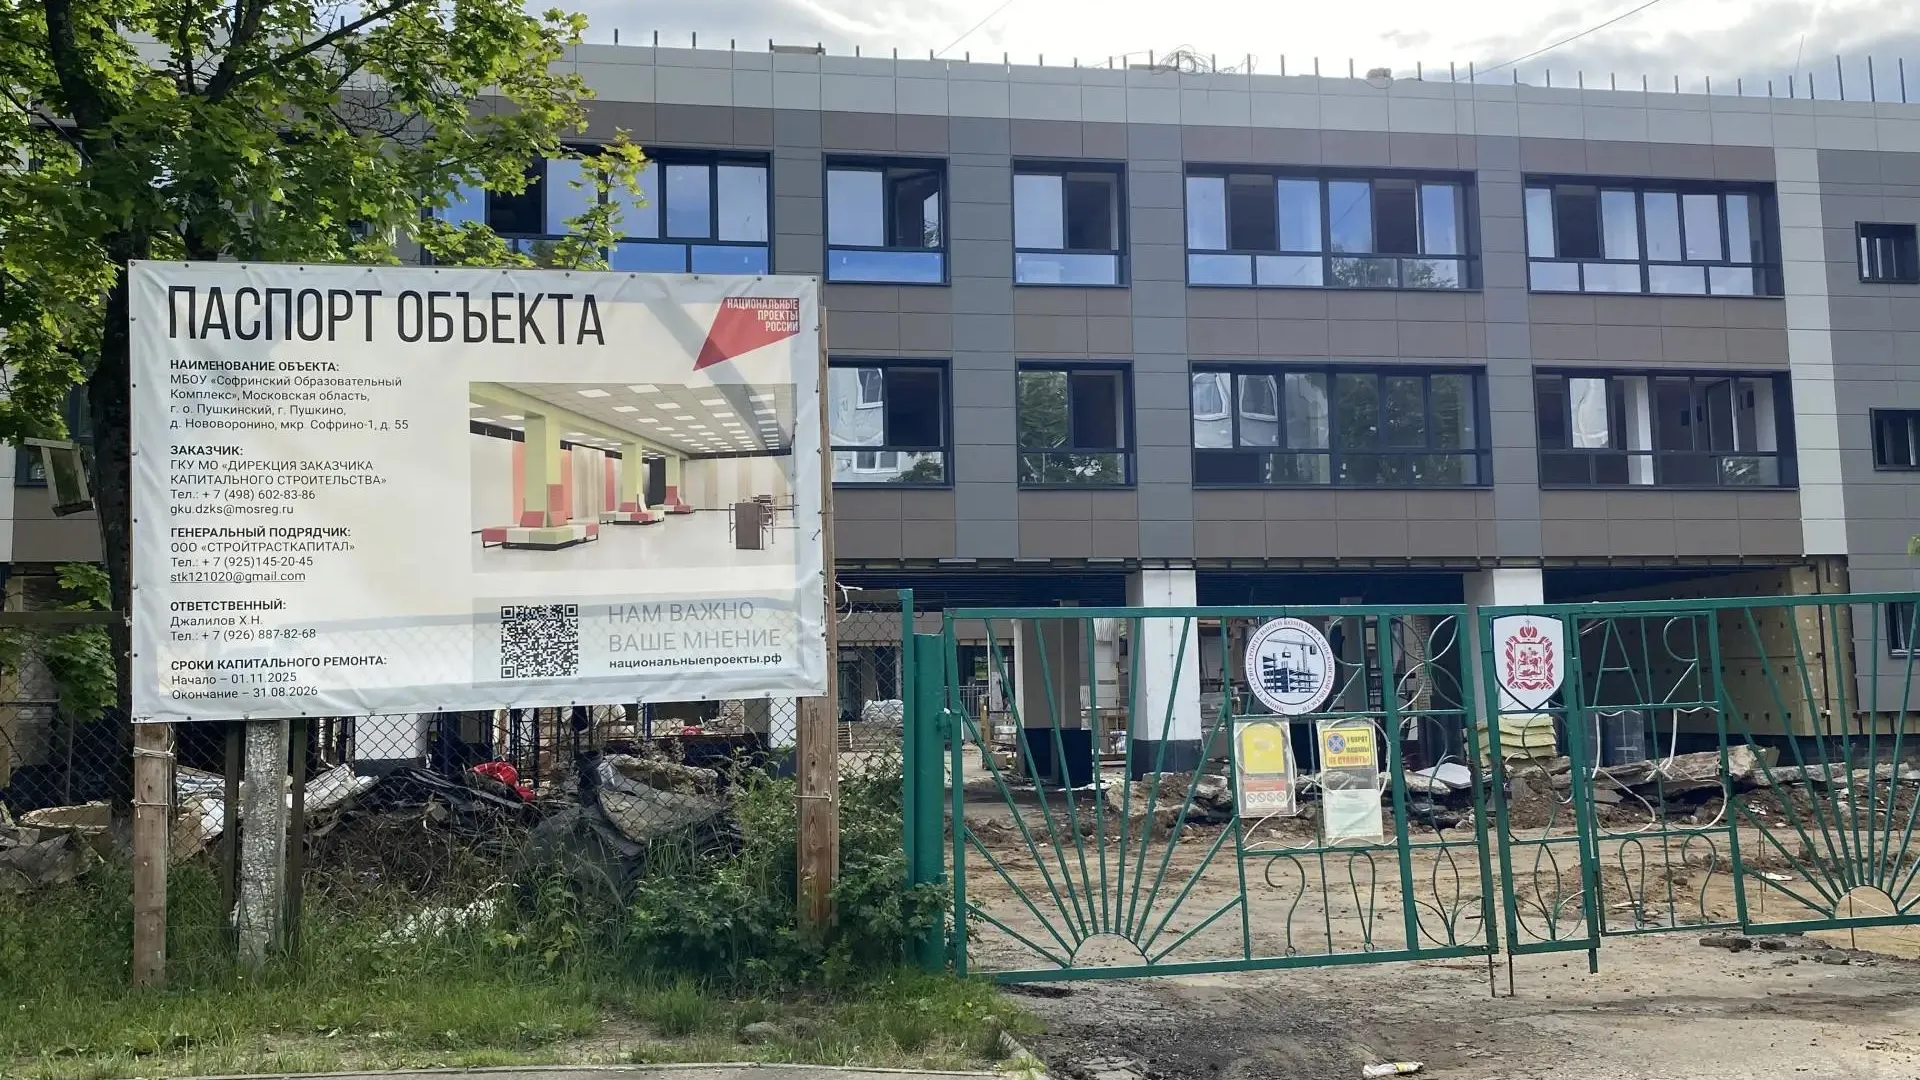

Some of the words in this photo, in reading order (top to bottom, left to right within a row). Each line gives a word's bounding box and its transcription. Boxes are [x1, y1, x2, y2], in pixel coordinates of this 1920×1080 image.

[728, 299, 797, 311] НАЦИОНАЛЬНЫЕ
[168, 286, 382, 341] ПАСПОРТ
[398, 290, 605, 345] ОБЪЕКТА
[758, 310, 797, 321] ПРОЕКТЫ
[765, 321, 798, 332] РОССИИ
[171, 360, 275, 371] НАИМЕНОВАНИЕ
[279, 362, 339, 371] ОБЪЕКТА:
[171, 374, 207, 386] МБОУ
[211, 375, 290, 387] «Софринский
[294, 376, 401, 388] Образовательный
[171, 389, 239, 401] Комплекс»,
[243, 390, 315, 400] Московская
[319, 391, 369, 401] область,
[197, 404, 274, 416] Пушкинский,
[290, 405, 346, 417] Пушкино,
[186, 418, 277, 431] Нововоронино,
[311, 420, 376, 431] Софрино-1,
[395, 420, 408, 429] 55
[171, 445, 243, 455] ЗАКАЗЧИК:
[171, 460, 194, 469] ГКУ
[199, 460, 218, 470] МО
[222, 461, 296, 472] «ДИРЕКЦИЯ
[300, 461, 373, 470] ЗАКАЗЧИКА
[171, 475, 273, 484] КАПИТАЛЬНОГО
[278, 475, 386, 485] СТРОИТЕЛЬСТВА»
[213, 490, 220, 498] 7
[225, 489, 254, 501] (498)
[259, 490, 315, 499] 602-83-86
[171, 504, 293, 516] gku.dzks@mosreg.ru
[171, 526, 265, 537] ГЕНЕРАЛЬНЫЙ
[270, 528, 351, 539] ПОДРЯДЧИК:
[171, 543, 197, 552] ООО
[202, 541, 354, 552] «СТРОЙТРАСТКАПИТАЛ»
[213, 557, 220, 567] 7
[224, 557, 313, 568] (925)145-20-45
[171, 571, 305, 583] stk121020@gmail.com
[171, 598, 286, 611] ОТВЕТСТВЕННЫЙ:
[608, 604, 663, 625] НАМ
[669, 601, 754, 622] ВАЖНО
[170, 617, 235, 628] Джалилов
[240, 616, 263, 625] Х.Н.
[213, 631, 220, 640] 7
[224, 629, 254, 642] (926)
[259, 629, 315, 639] 887-82-68
[608, 632, 676, 652] ВАШЕ
[684, 629, 781, 649] МНЕНИЕ
[171, 660, 213, 670] СРОКИ
[218, 658, 320, 669] КАПИТАЛЬНОГО
[324, 656, 387, 666] РЕМОНТА:
[610, 653, 781, 668] национальныепроекты.рф
[172, 676, 216, 684] Начало
[232, 672, 296, 683] 01.11.2025
[172, 690, 238, 700] Окончание
[253, 686, 317, 697] 31.08.2026
